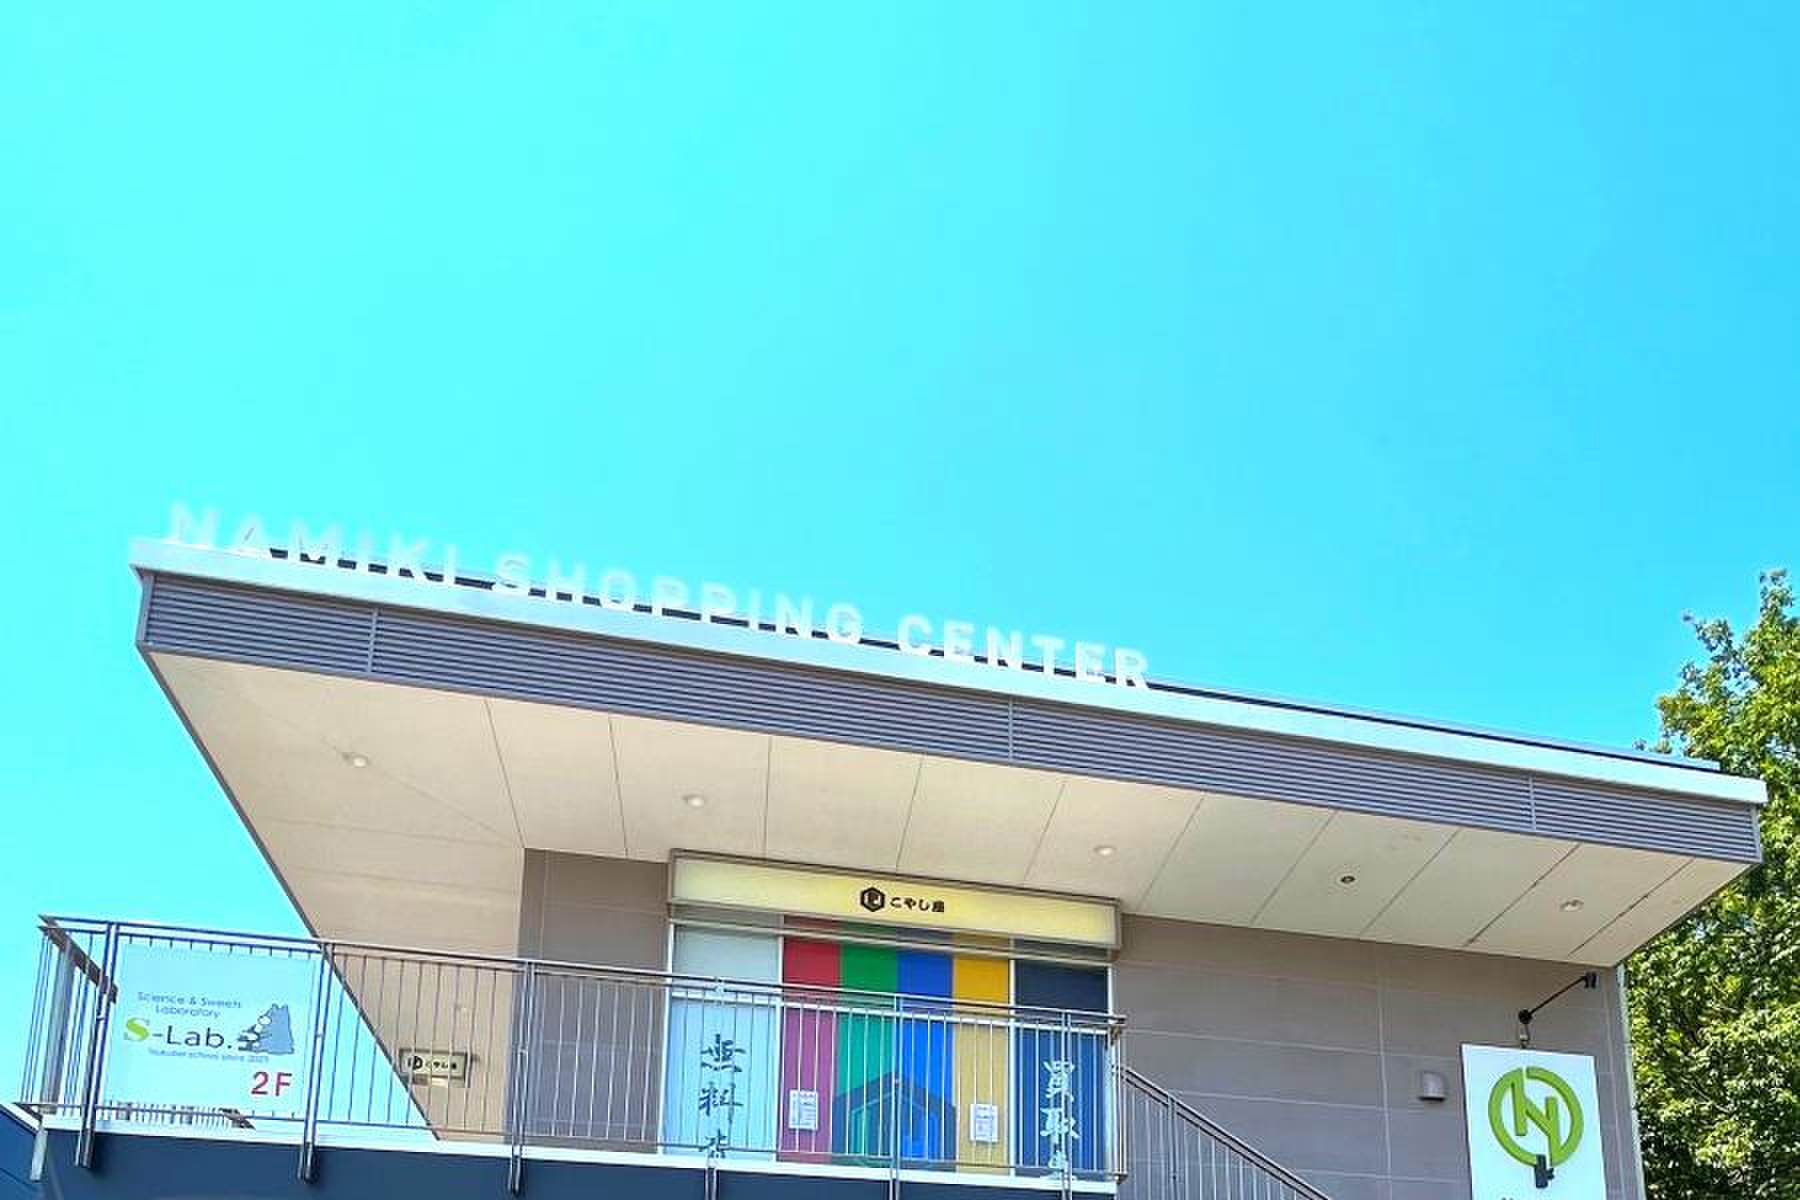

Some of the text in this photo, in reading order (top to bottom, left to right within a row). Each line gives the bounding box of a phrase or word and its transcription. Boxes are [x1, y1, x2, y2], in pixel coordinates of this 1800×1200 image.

[168, 503, 1150, 689] NAMIKI SHOPPING CENTER
[155, 1005, 221, 1018] Laboratory
[251, 1070, 293, 1096] 2F
